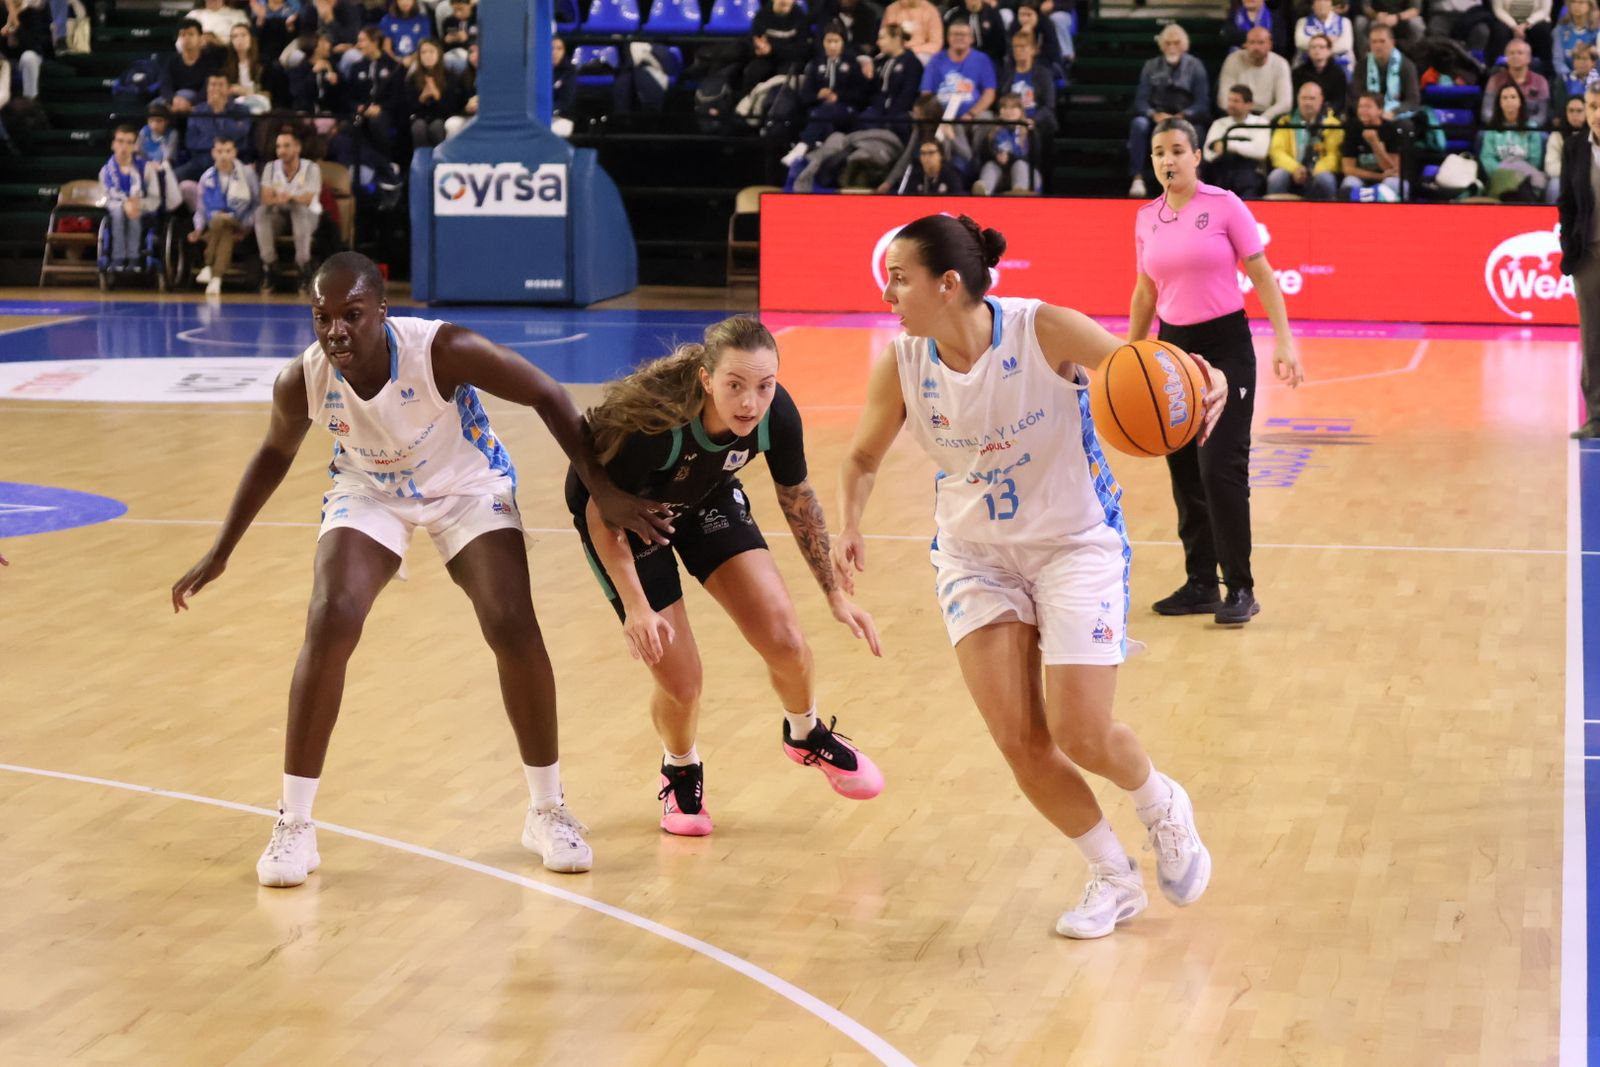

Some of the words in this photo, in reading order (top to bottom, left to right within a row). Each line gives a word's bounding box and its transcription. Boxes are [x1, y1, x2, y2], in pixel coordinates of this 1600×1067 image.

[438, 171, 562, 207] oyrsa
[1499, 268, 1577, 299] WeA
[995, 426, 1005, 439] Y
[1010, 408, 1045, 434] LEÓN
[983, 478, 1019, 520] 13
